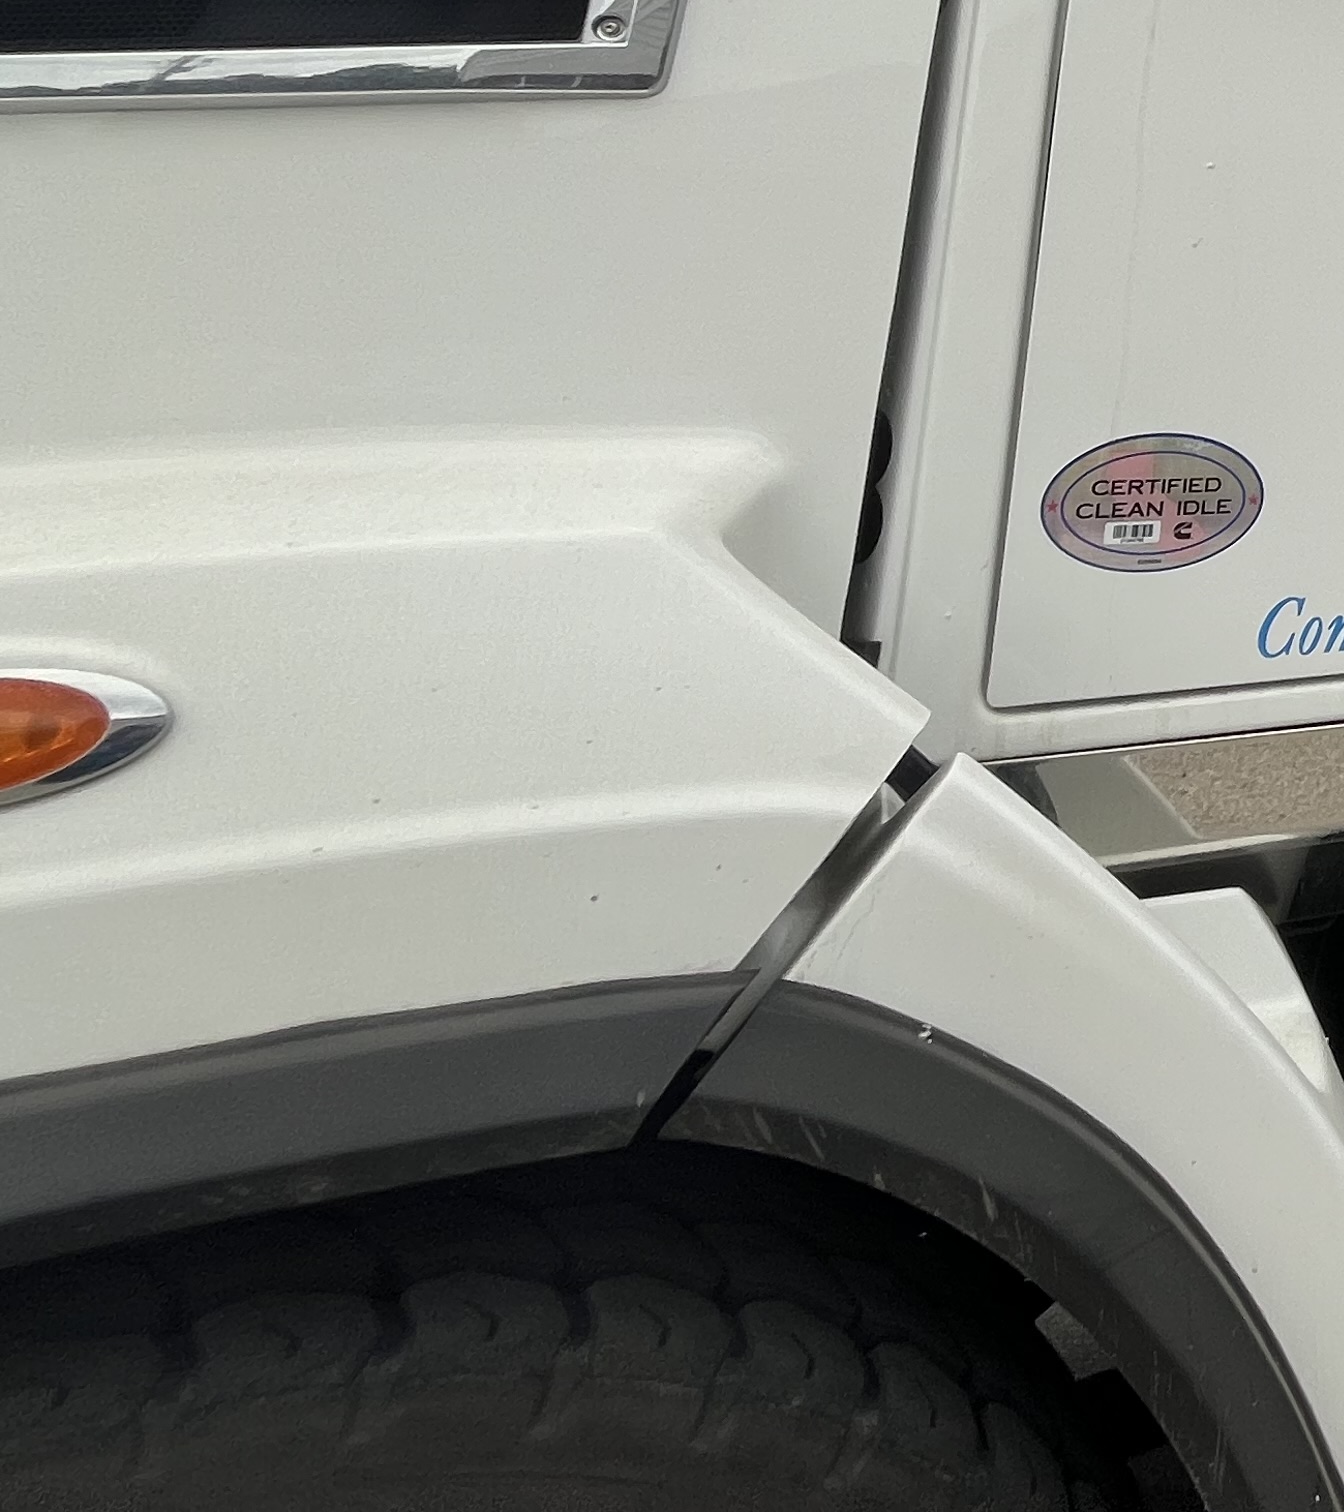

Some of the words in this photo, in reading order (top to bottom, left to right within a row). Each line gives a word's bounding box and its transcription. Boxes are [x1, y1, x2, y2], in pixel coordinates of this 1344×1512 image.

[1091, 477, 1222, 496] CERTIFIED
[1075, 500, 1165, 520] CLEAN
[1176, 499, 1233, 516] IDLE
